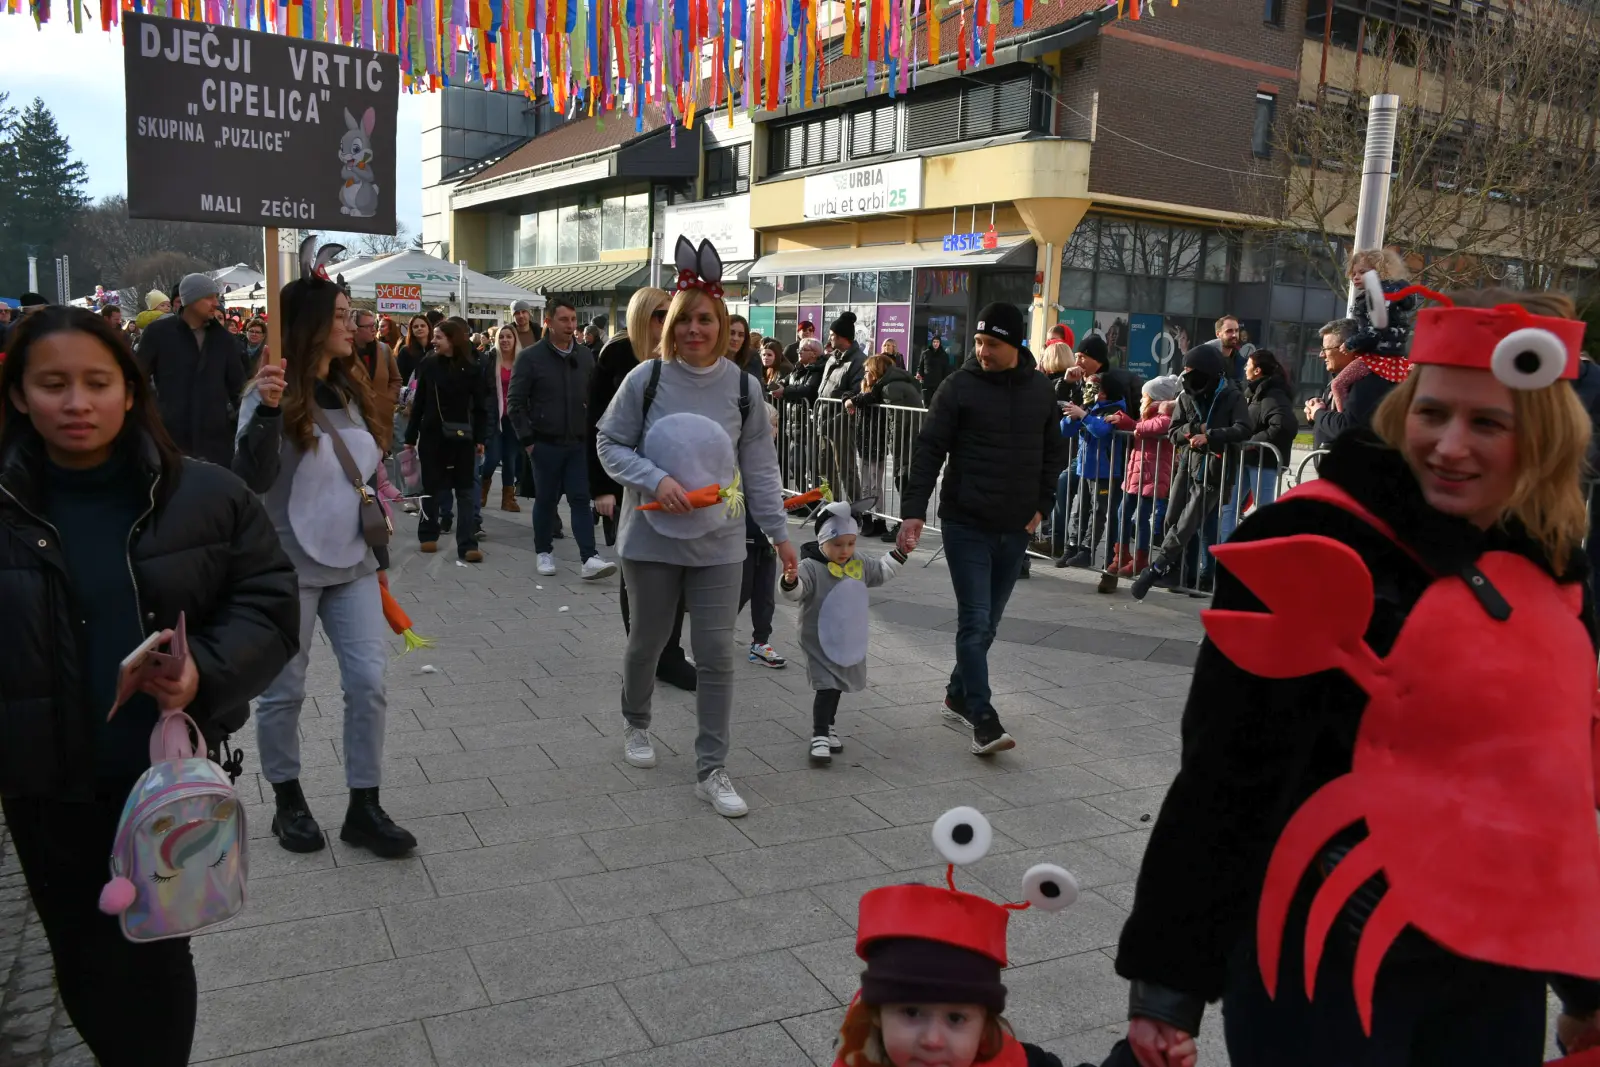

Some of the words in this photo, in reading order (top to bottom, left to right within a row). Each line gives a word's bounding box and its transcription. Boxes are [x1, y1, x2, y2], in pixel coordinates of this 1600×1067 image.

[140, 22, 251, 74] DJEČJI
[288, 46, 383, 93] VRTIĆ
[137, 115, 205, 143] SKUPINA
[849, 168, 884, 189] URBIA
[200, 193, 241, 214] MALI
[260, 196, 315, 220] ZEČIĆI
[813, 197, 837, 216] urbi
[841, 196, 854, 212] et
[858, 190, 884, 211] orbi
[888, 188, 907, 207] 25
[943, 232, 983, 252] ERSTE
